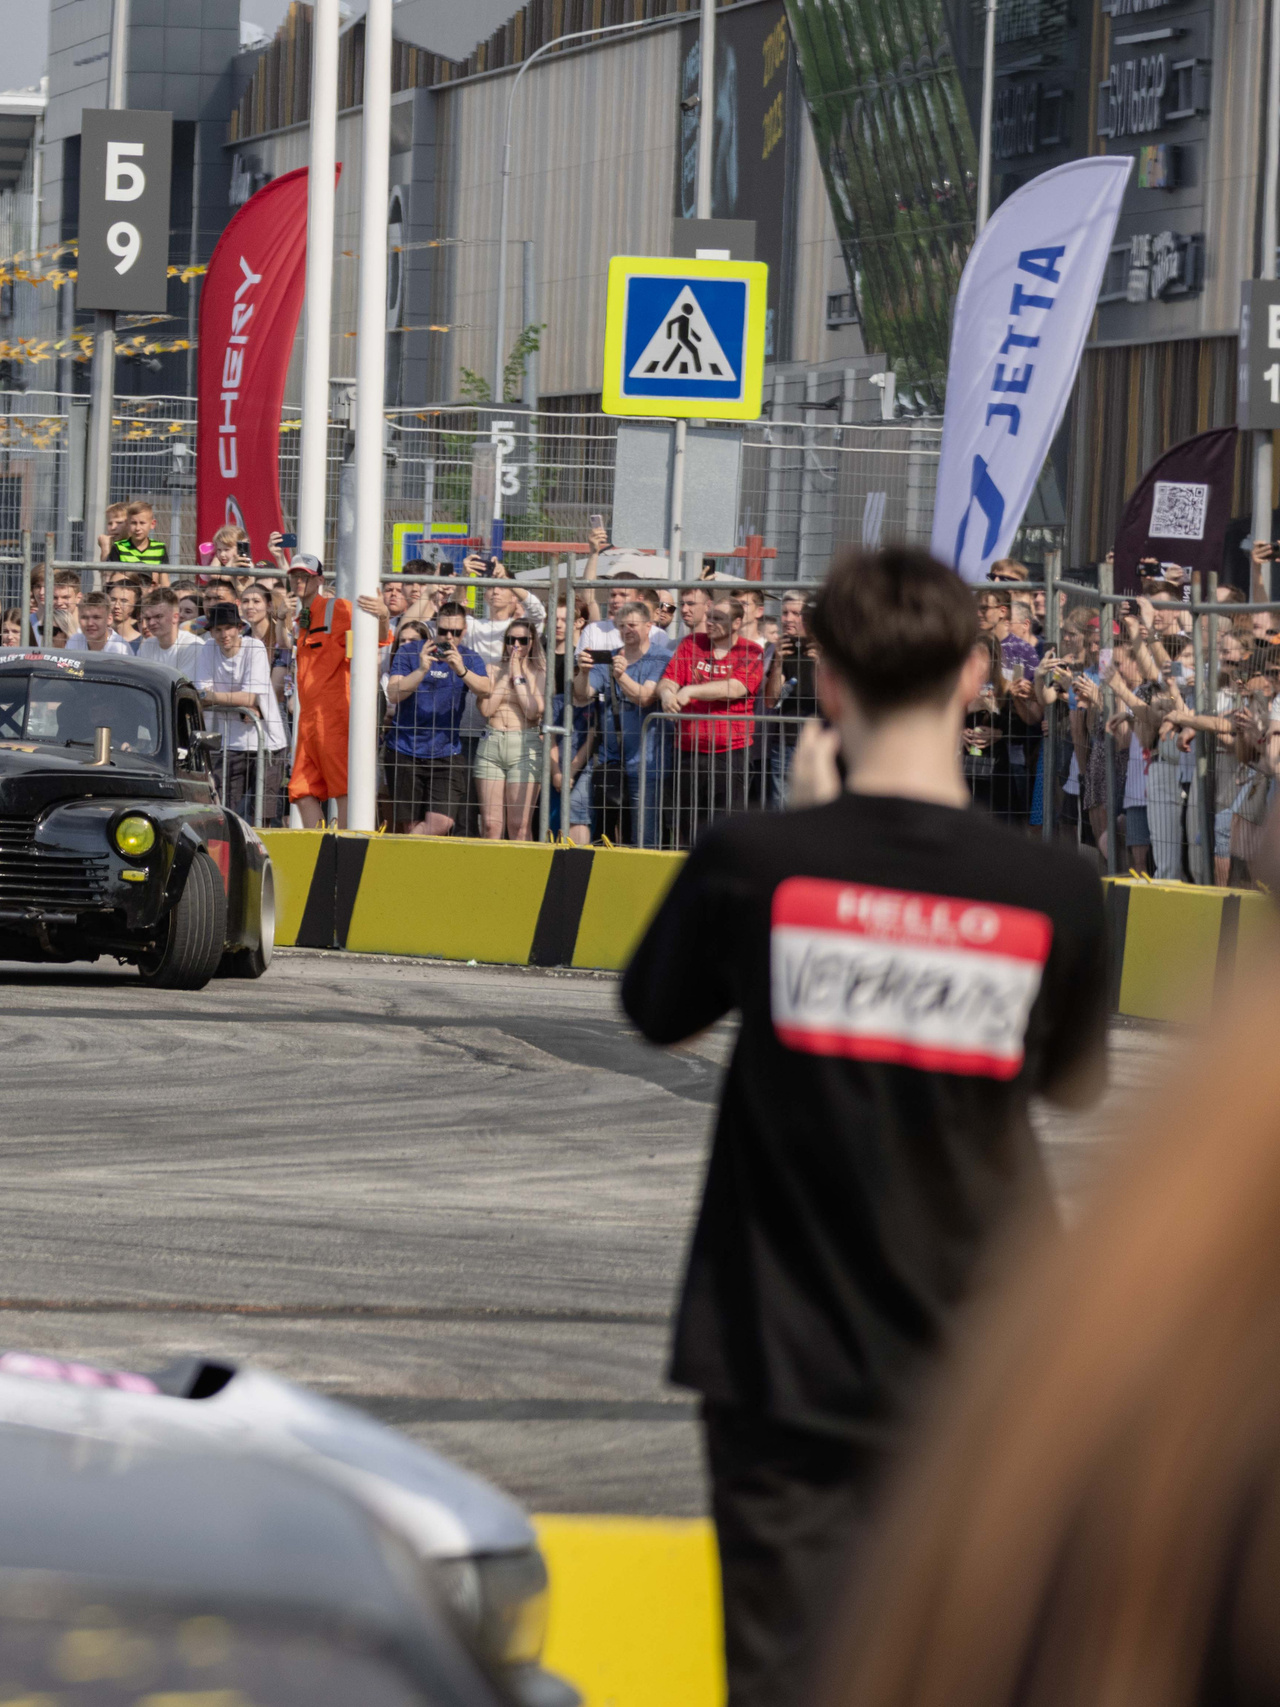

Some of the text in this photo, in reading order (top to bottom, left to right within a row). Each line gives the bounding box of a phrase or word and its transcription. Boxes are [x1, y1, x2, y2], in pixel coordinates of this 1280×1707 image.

[105, 141, 145, 202] Б
[106, 221, 142, 275] 9
[219, 256, 262, 479] CHERY
[985, 245, 1066, 437] JETTA
[836, 887, 1001, 945] HELLO
